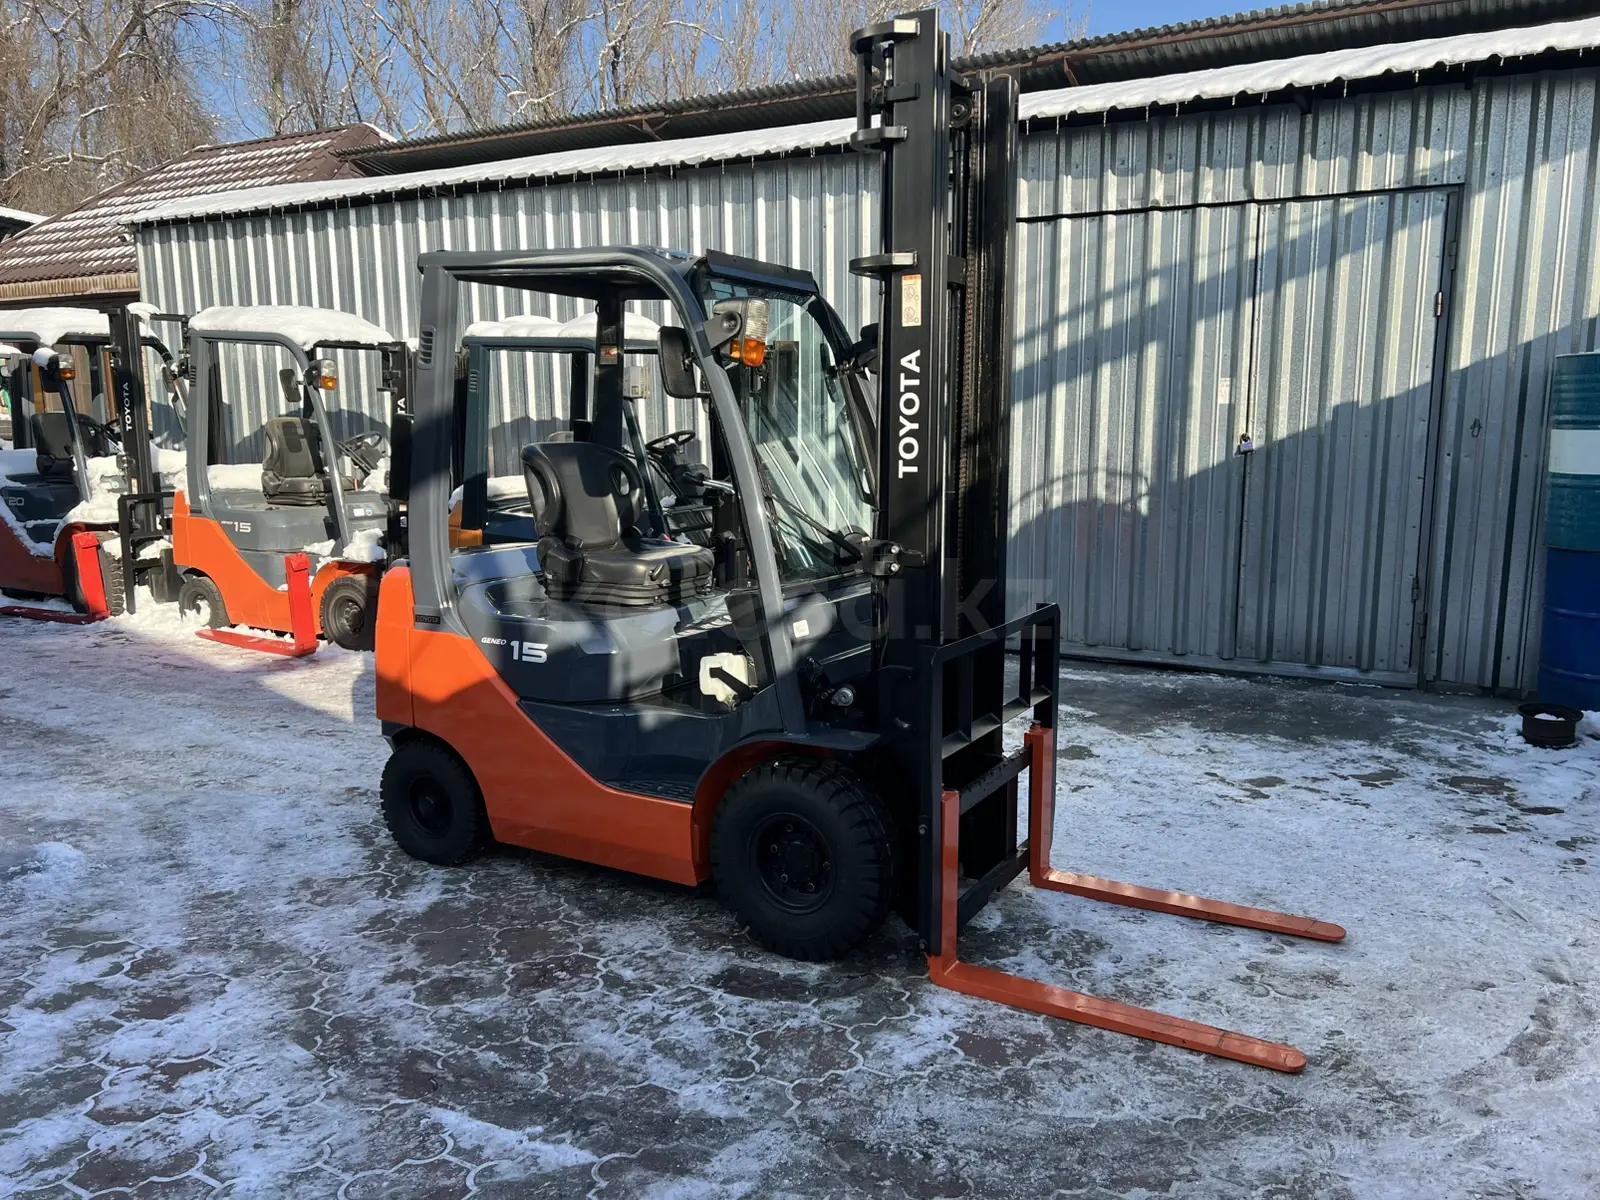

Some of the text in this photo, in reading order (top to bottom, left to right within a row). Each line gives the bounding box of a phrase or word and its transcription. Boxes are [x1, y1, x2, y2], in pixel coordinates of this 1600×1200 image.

[122, 382, 133, 431] TOYOTA
[898, 349, 921, 479] TOYOTA
[8, 496, 25, 506] 20
[234, 521, 252, 533] 15
[481, 636, 549, 664] GENEO 15
